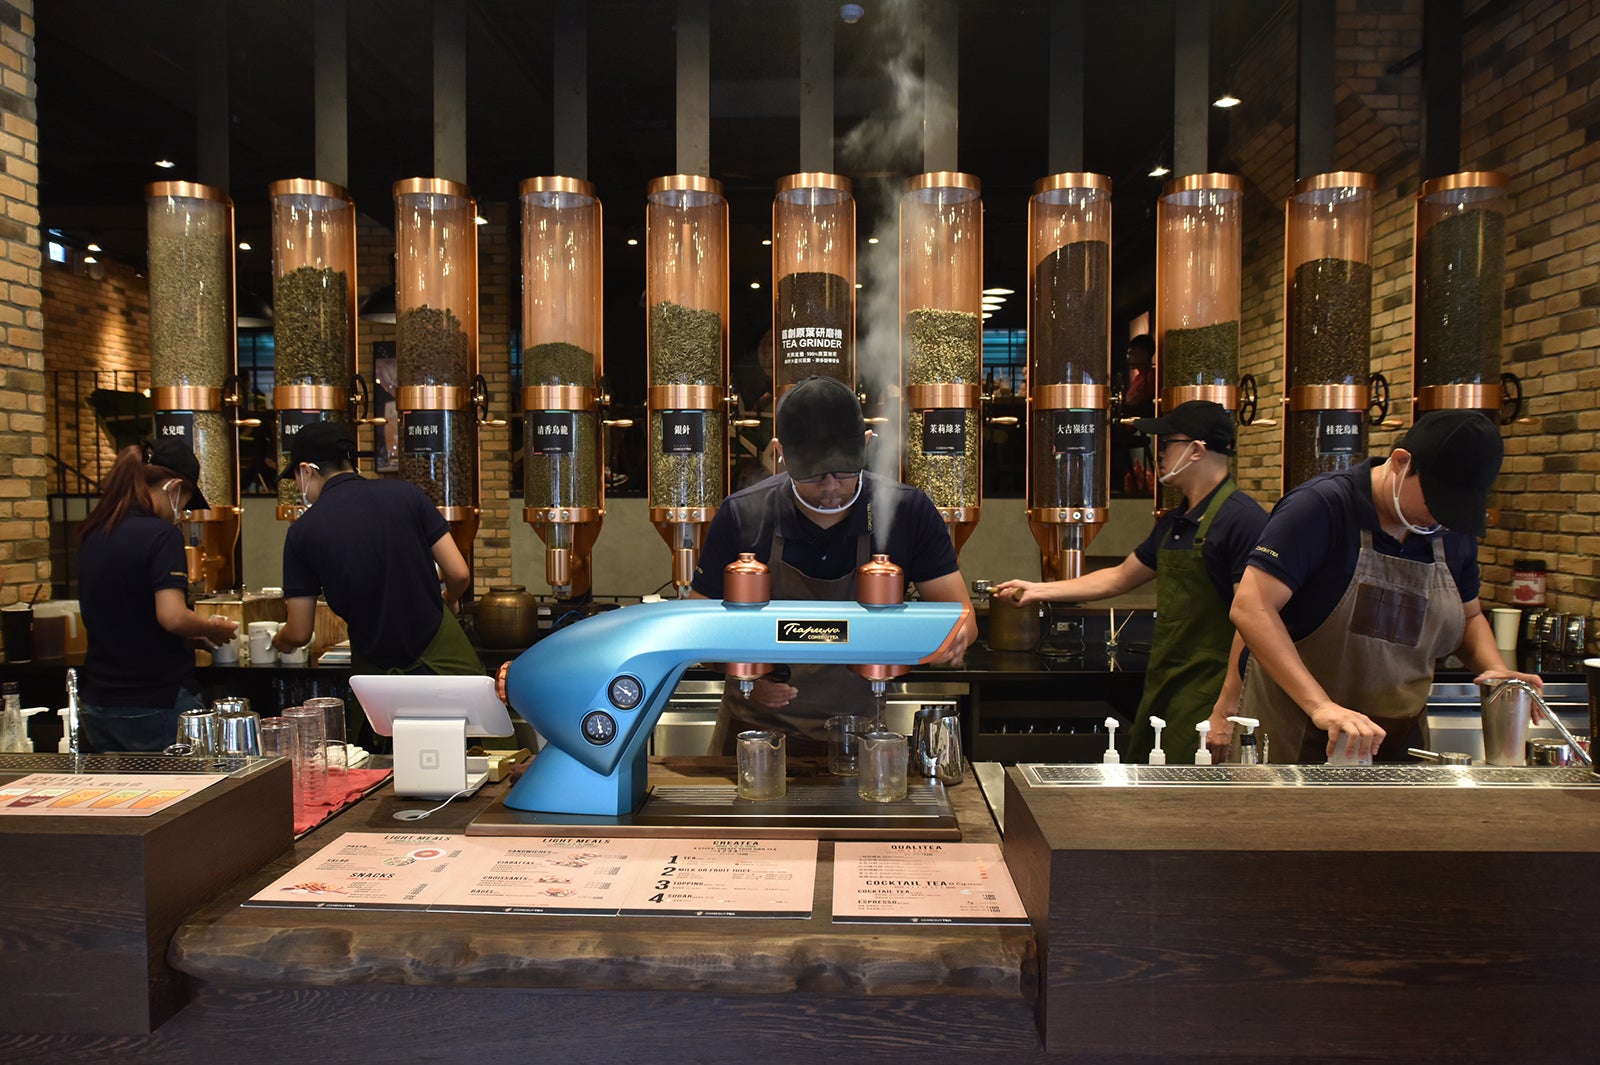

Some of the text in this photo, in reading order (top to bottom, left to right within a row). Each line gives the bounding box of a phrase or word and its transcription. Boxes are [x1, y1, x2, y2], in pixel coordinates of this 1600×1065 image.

[782, 338, 842, 349] TEA GRINDER
[929, 423, 962, 434] 茉莉綠茶
[1056, 423, 1096, 435] 大吉嶺紅茶
[1326, 424, 1359, 435] 桂花烏龍
[667, 855, 678, 866] 1
[660, 866, 677, 878] 2
[655, 879, 671, 891] 3
[648, 892, 665, 905] 4
